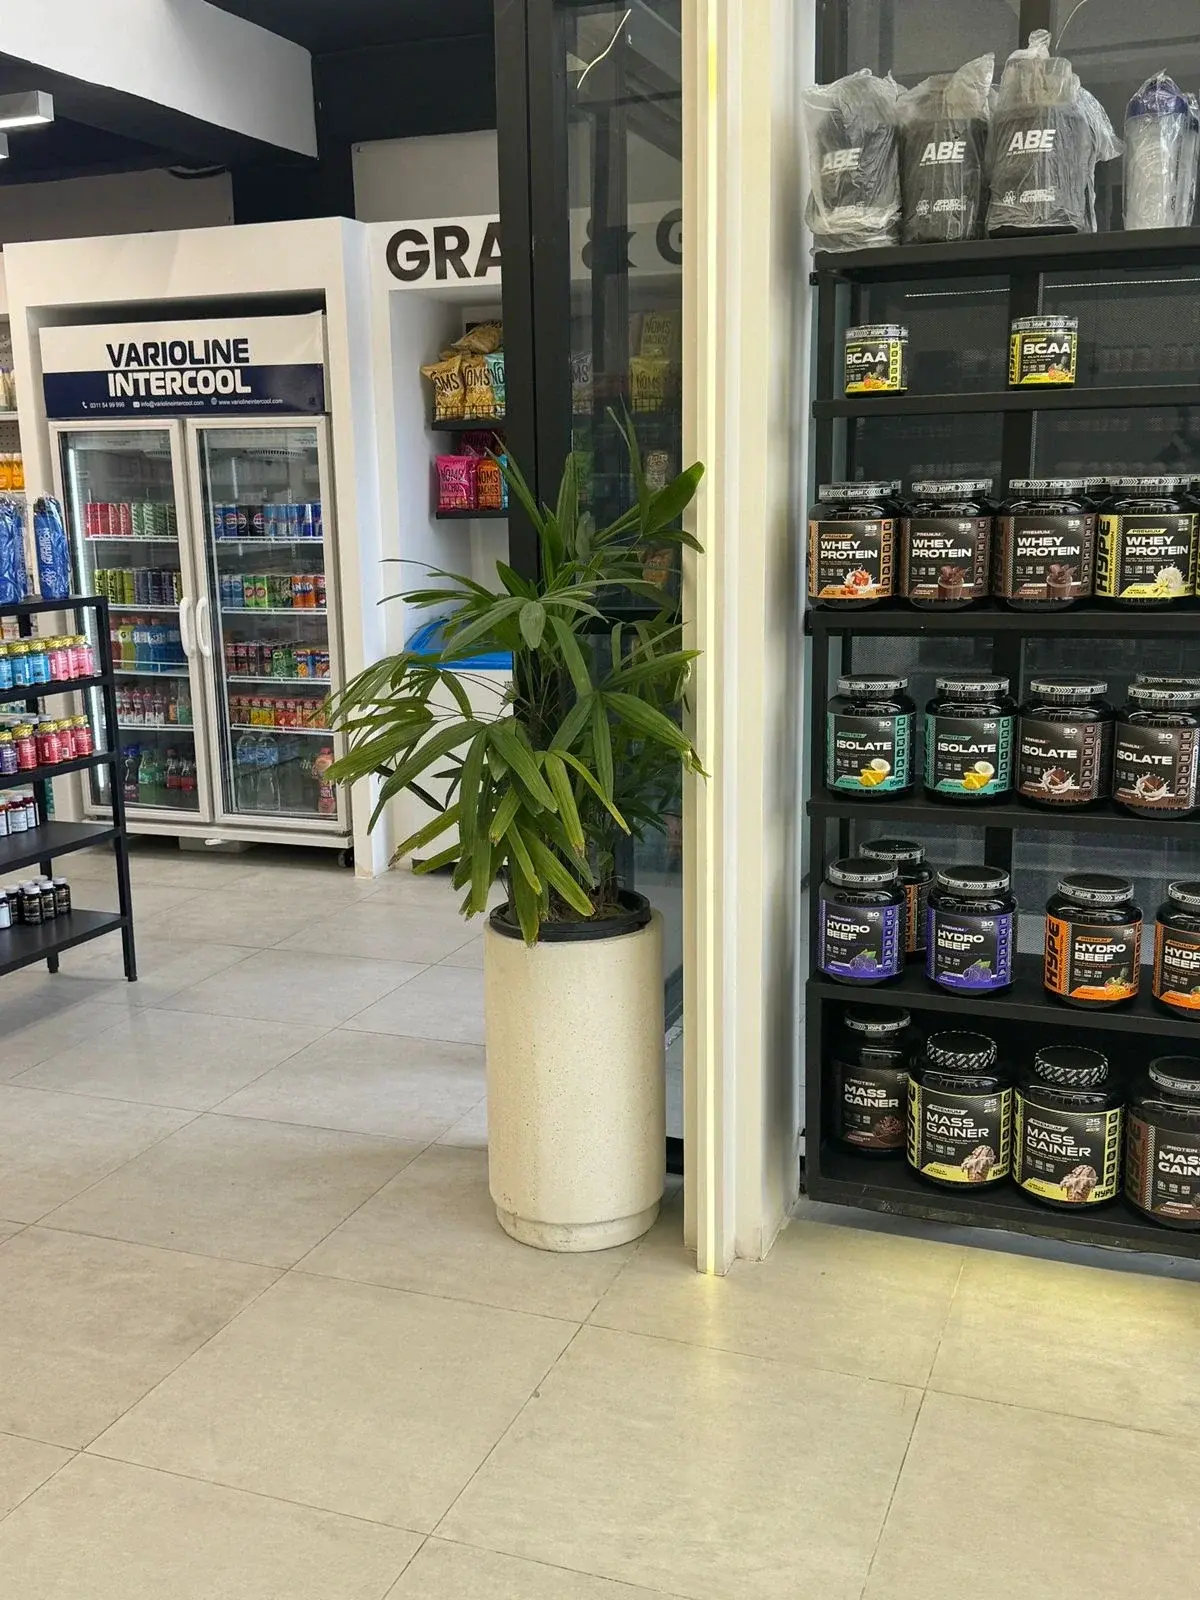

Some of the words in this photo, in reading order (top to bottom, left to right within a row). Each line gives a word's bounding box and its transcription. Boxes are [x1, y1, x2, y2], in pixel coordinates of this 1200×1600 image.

[1008, 129, 1056, 152] ABE
[921, 141, 967, 162] ABE
[821, 148, 862, 172] ABE
[106, 338, 250, 368] VARIOLINE
[1023, 342, 1071, 355] BCAA
[846, 351, 888, 364] BCAA
[108, 368, 251, 397] INTERCOOL
[820, 540, 861, 550] WHEY
[912, 539, 954, 548] WHEY
[1017, 536, 1064, 547] WHEY
[1126, 536, 1174, 546] WHEY
[820, 550, 878, 560] PROTEIN
[912, 548, 972, 558] PROTEIN
[1016, 546, 1080, 557] PROTEIN
[1125, 545, 1189, 556] PROTEIN
[1157, 732, 1173, 740] 30
[836, 739, 892, 751] ISOLATE
[937, 742, 996, 753] ISOLATE
[1021, 744, 1078, 759] ISOLATE
[1116, 750, 1173, 765] ISOLATE
[826, 919, 870, 934] HYDRO
[826, 929, 857, 942] BEEF
[937, 929, 985, 943] HYDRO
[937, 939, 971, 952] BEEF
[1075, 942, 1127, 953] HYDRO
[1046, 919, 1060, 988] HYPE
[1074, 952, 1114, 963] BEEF
[1164, 954, 1200, 970] BEEF
[849, 1078, 875, 1087] PROTEIN
[844, 1083, 887, 1099] MASS
[844, 1094, 899, 1108] GAINER
[984, 1098, 998, 1107] 25
[926, 1111, 975, 1128] MASS
[1086, 1118, 1101, 1126] 25
[926, 1123, 990, 1138] GAINER
[1027, 1124, 1075, 1146] MASS
[1026, 1137, 1092, 1157] GAINER
[1166, 1145, 1198, 1153] PROTEIN
[1158, 1150, 1200, 1165] MAS
[1094, 1186, 1115, 1199] HYPE
